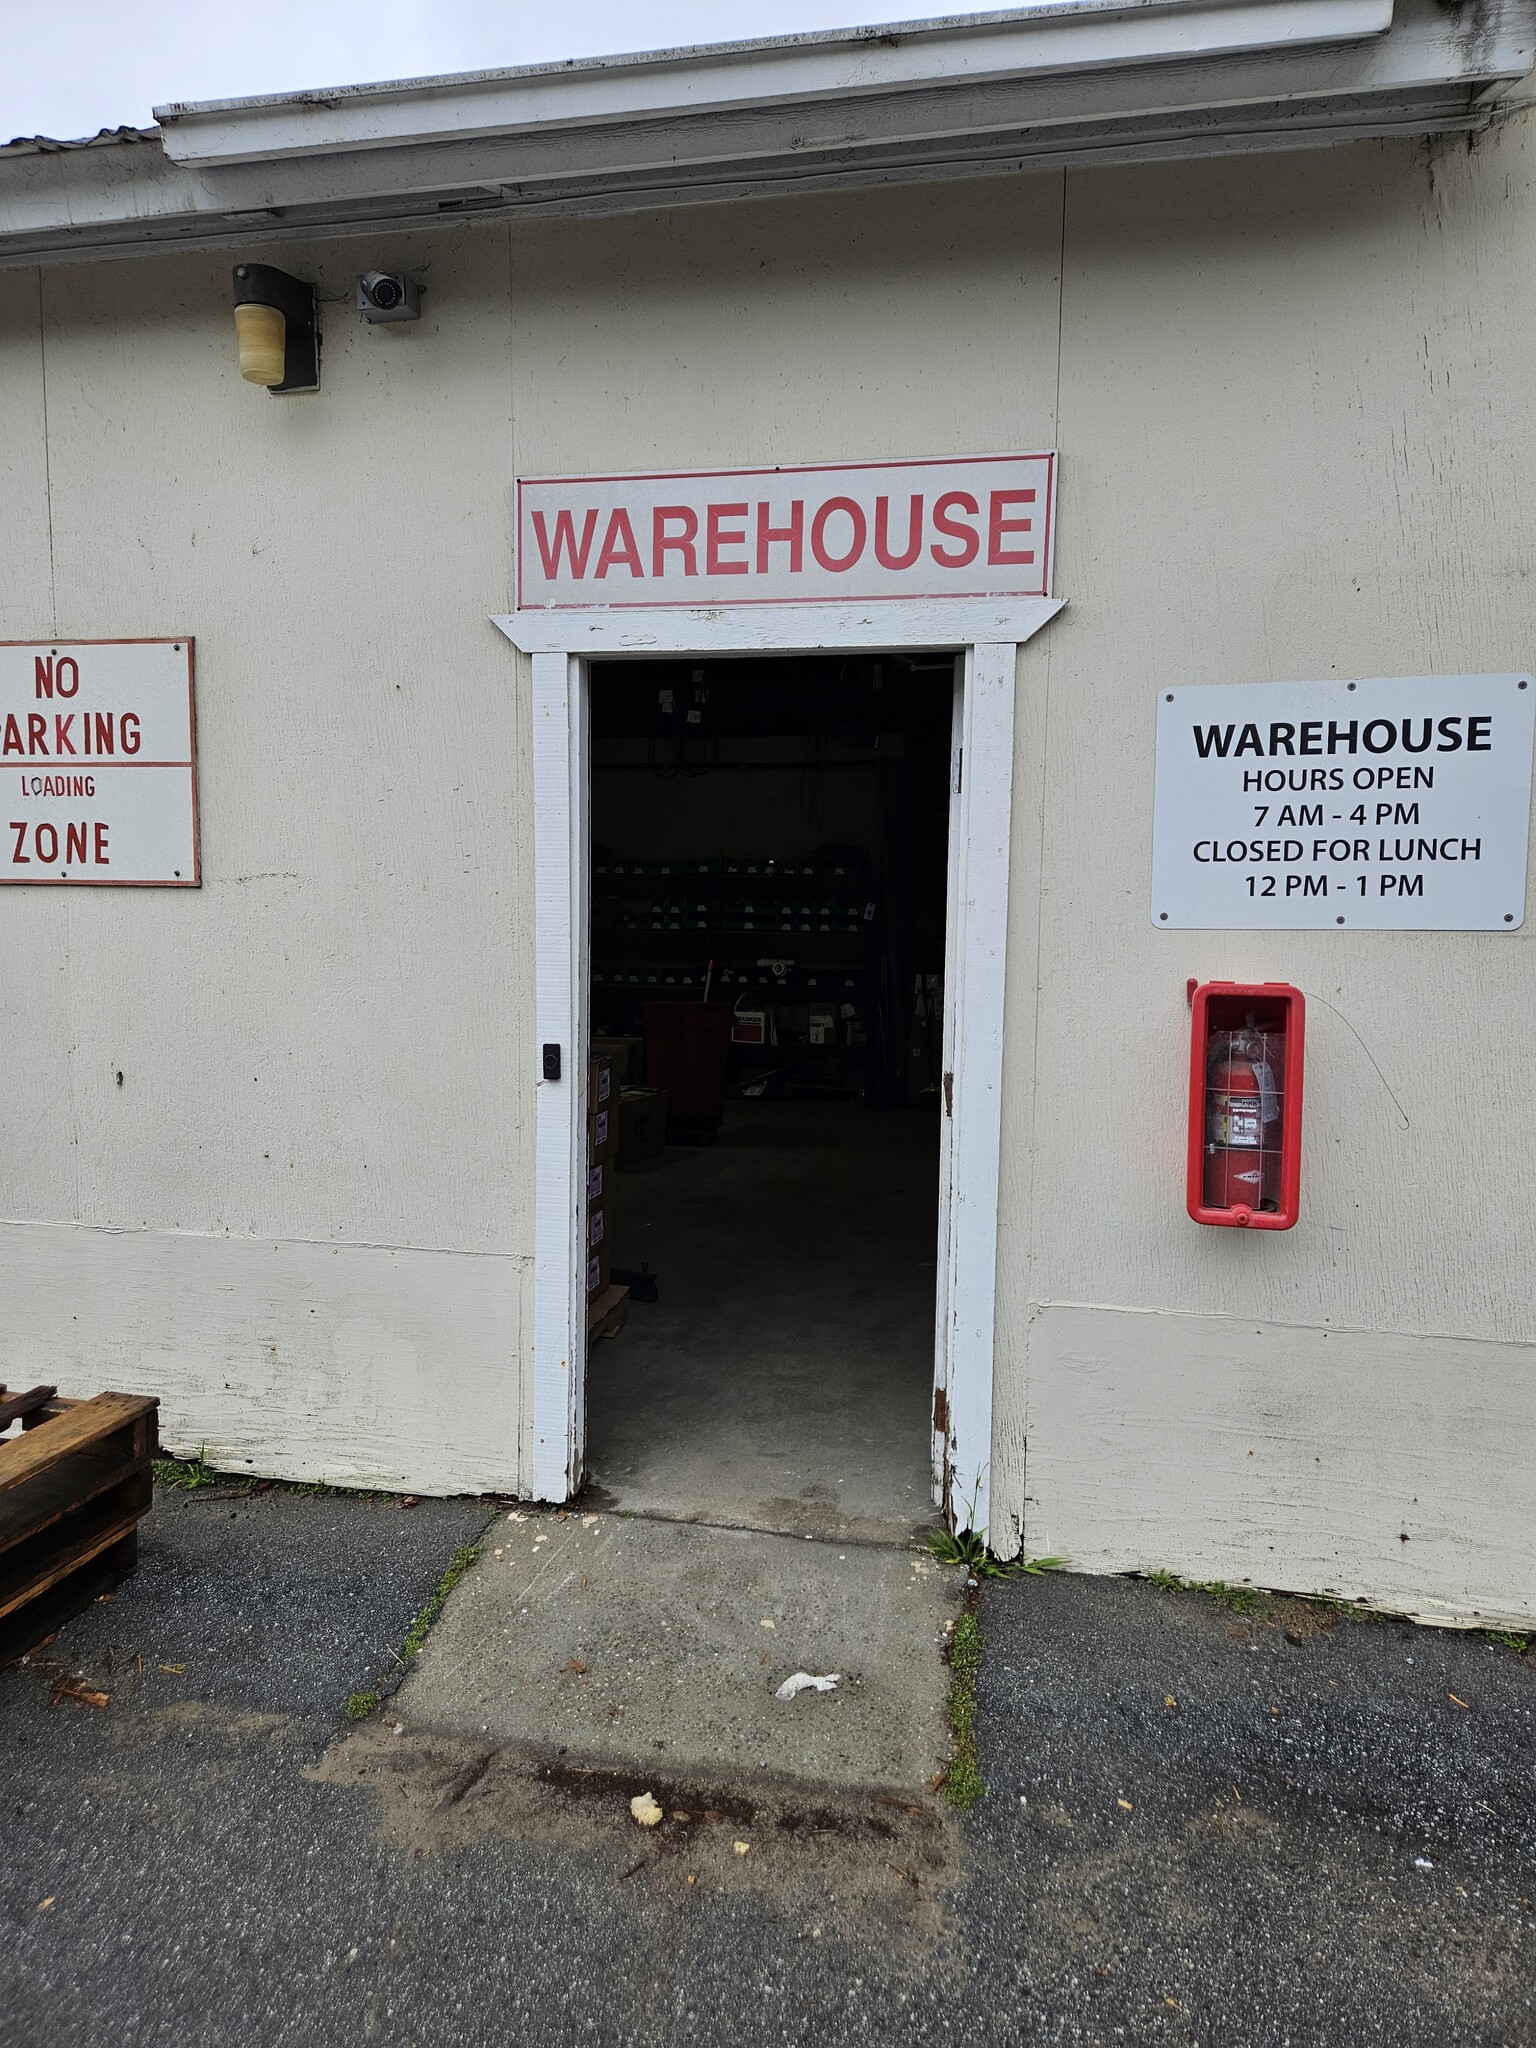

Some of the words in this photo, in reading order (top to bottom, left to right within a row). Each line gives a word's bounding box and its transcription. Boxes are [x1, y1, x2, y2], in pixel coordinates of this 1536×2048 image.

[531, 488, 1036, 580] WAREHOUSE
[35, 656, 79, 698] NO
[0, 712, 141, 755] ARKING
[1193, 716, 1492, 758] WAREHOUSE
[22, 775, 95, 797] LOADING
[1243, 767, 1343, 793] HOURS
[1353, 766, 1434, 790] OPEN
[1254, 805, 1270, 827] 7
[1277, 804, 1324, 827] AM
[1350, 804, 1367, 826] 4
[1376, 802, 1420, 826] PM
[9, 821, 110, 865] ZONE
[1193, 840, 1304, 863] CLOSED
[1313, 839, 1370, 862] FOR
[1379, 838, 1482, 861] LUNCH
[1245, 875, 1277, 897] 12
[1286, 874, 1328, 897] PM
[1356, 875, 1367, 897] 1
[1380, 874, 1424, 897] PM
